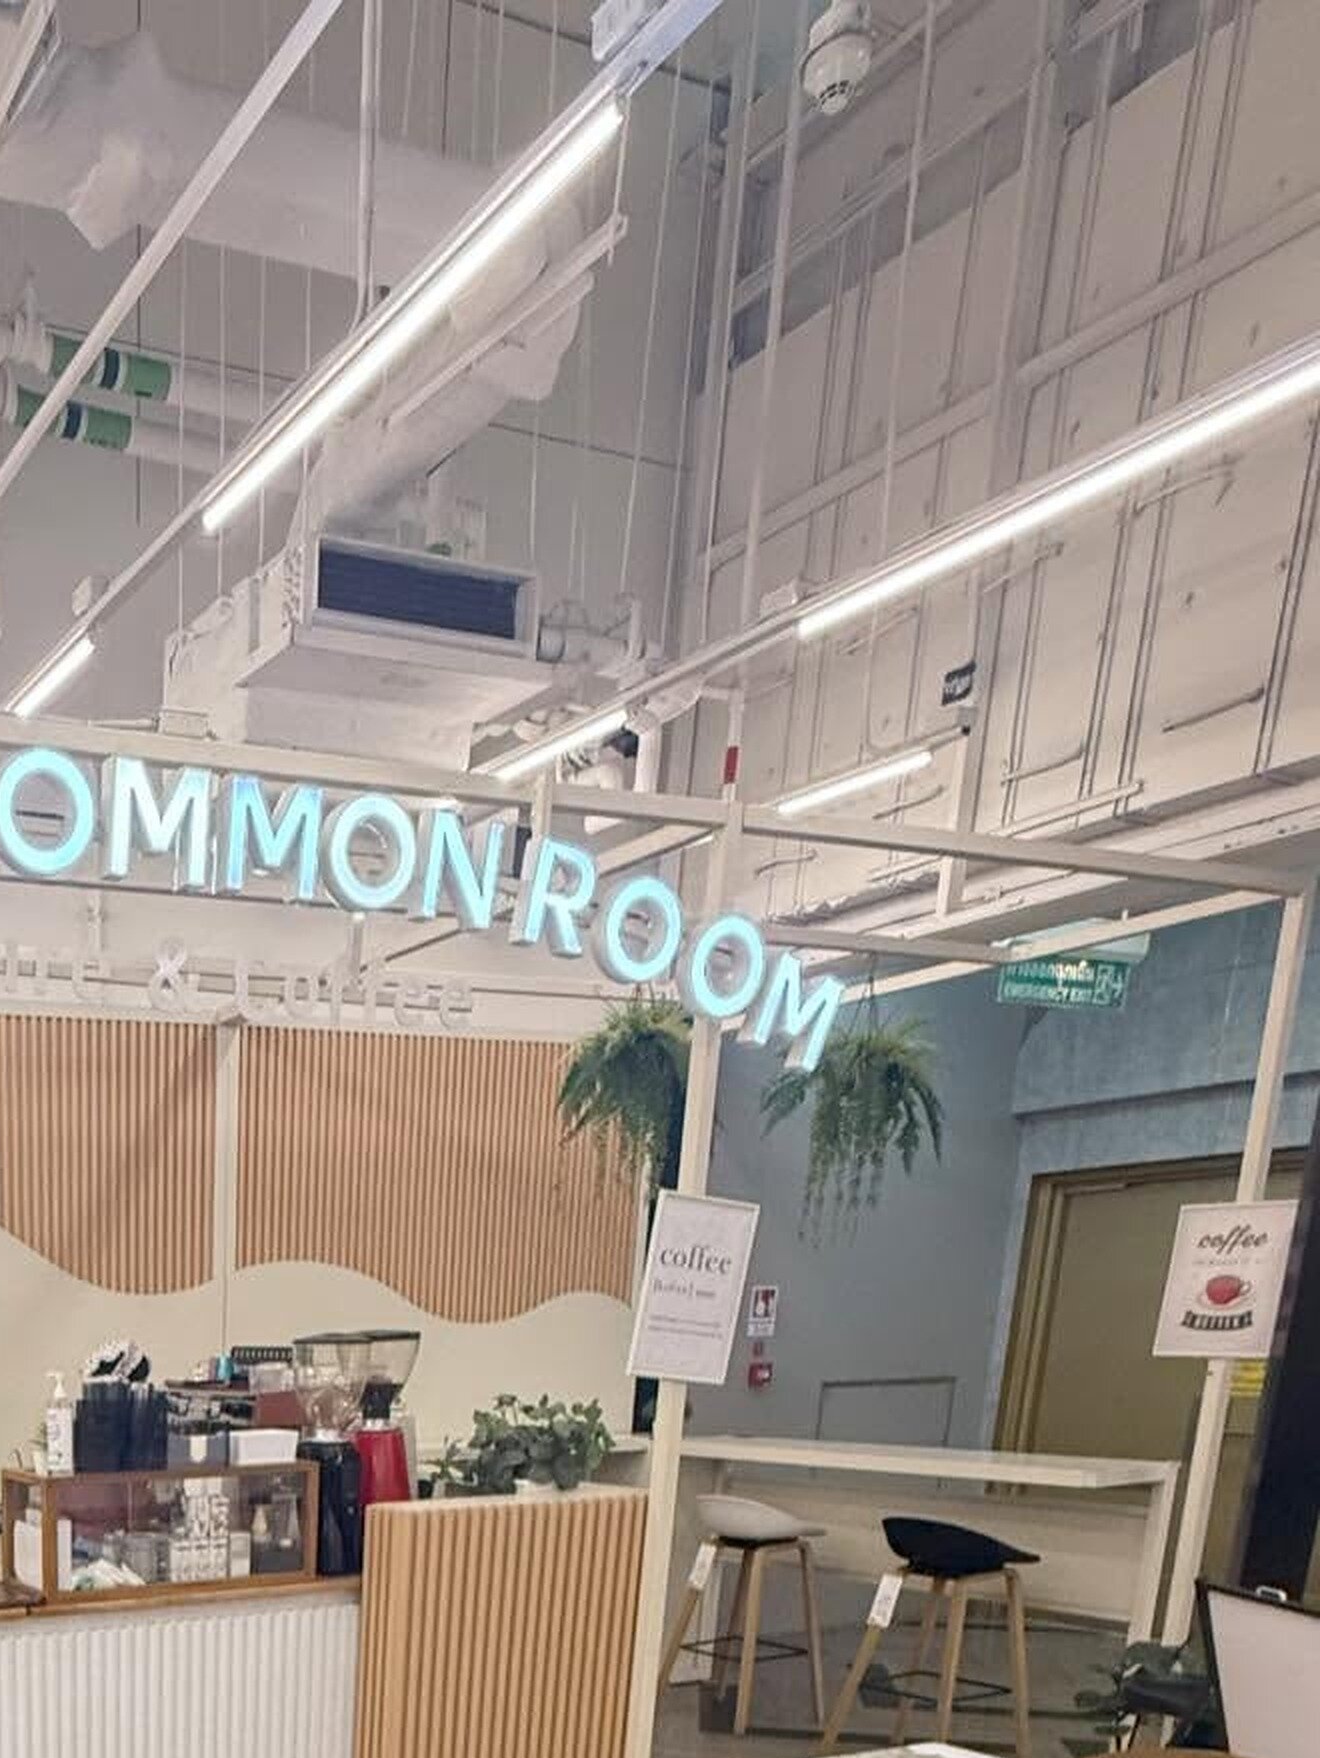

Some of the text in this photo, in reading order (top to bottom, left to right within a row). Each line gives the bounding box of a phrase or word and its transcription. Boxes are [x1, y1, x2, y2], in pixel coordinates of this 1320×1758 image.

[514, 836, 847, 1071] ROOM
[1196, 1223, 1268, 1255] coffee
[660, 1244, 732, 1275] coffee
